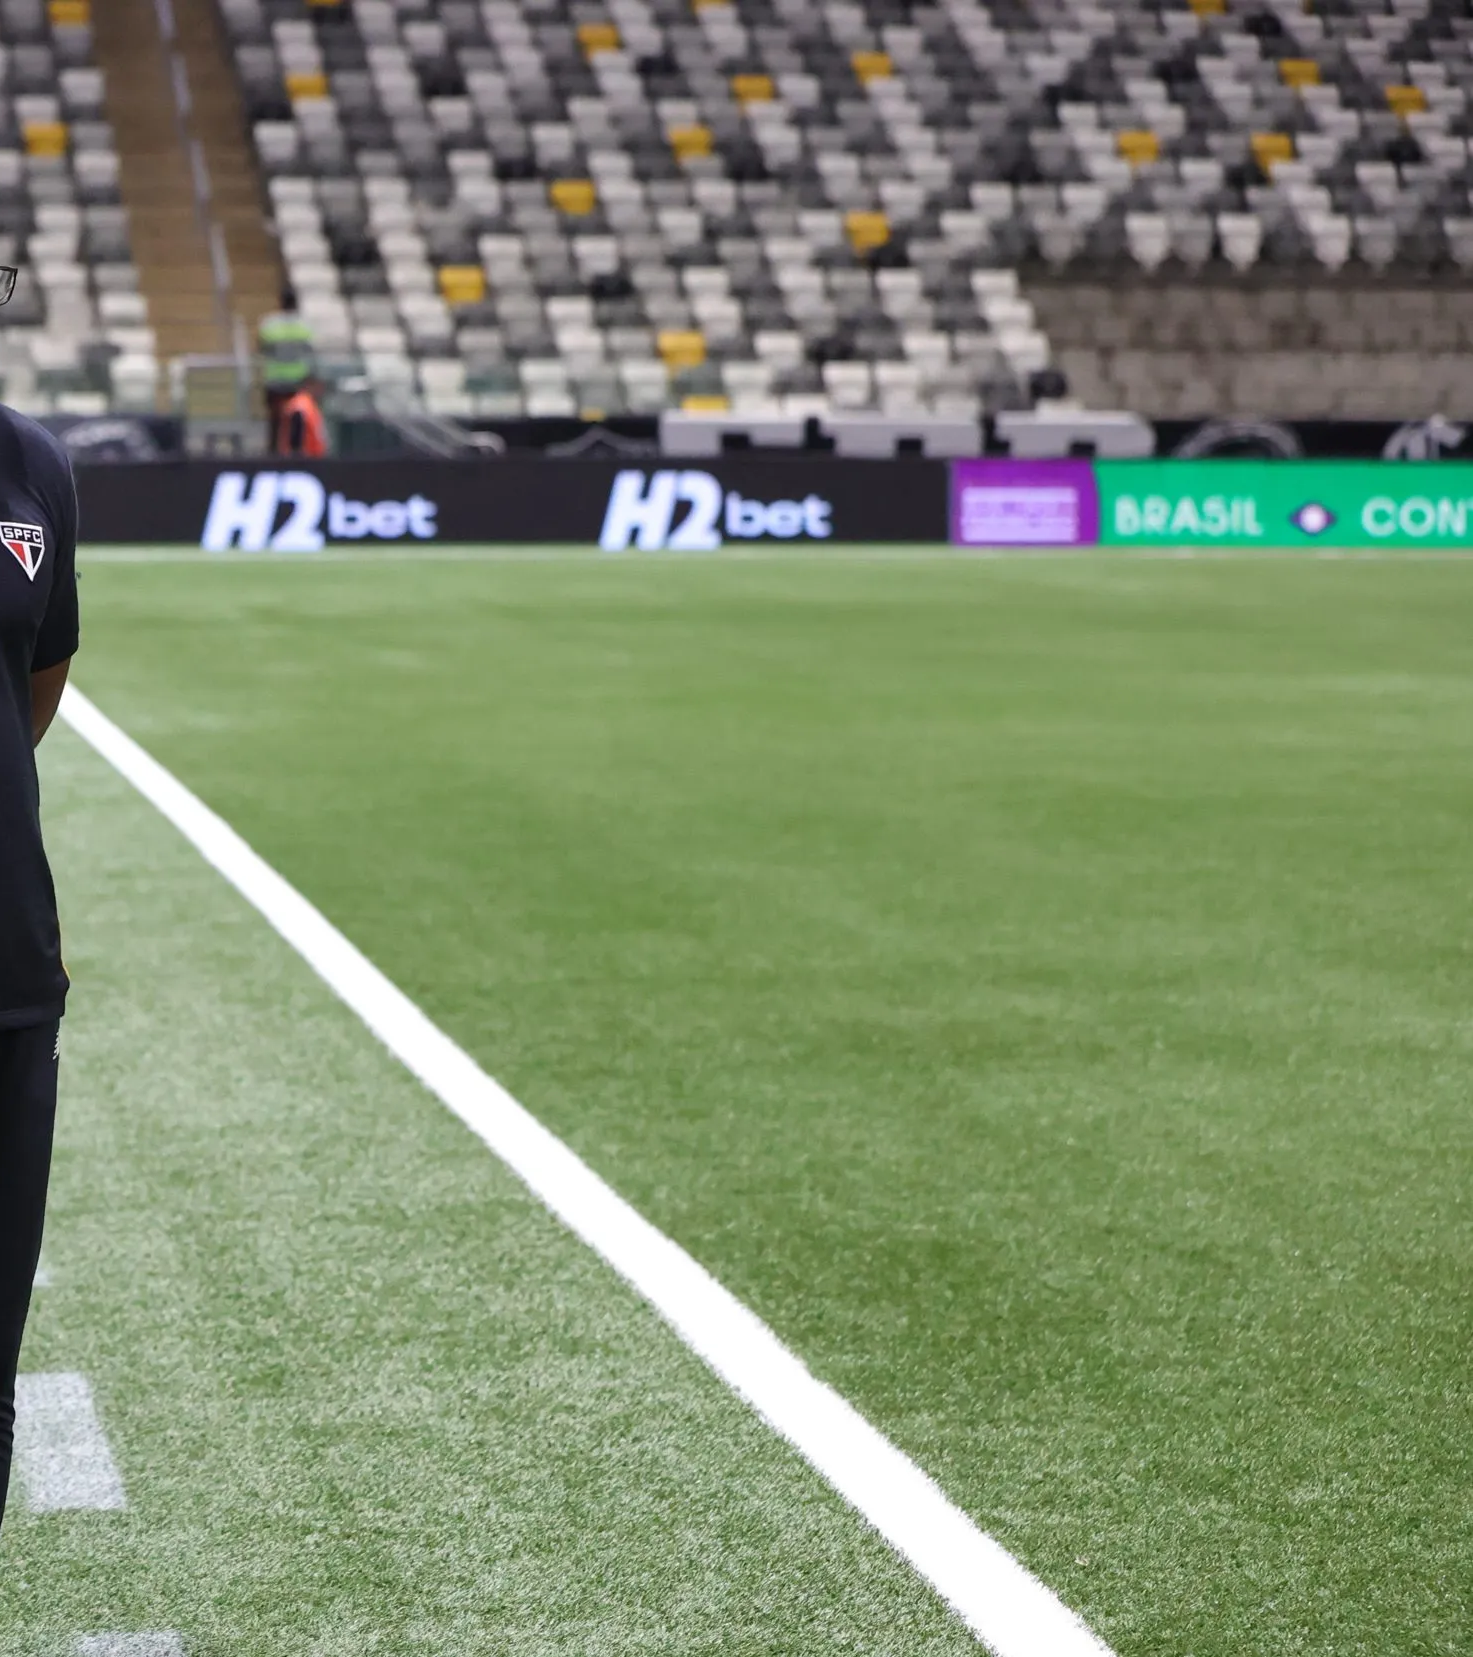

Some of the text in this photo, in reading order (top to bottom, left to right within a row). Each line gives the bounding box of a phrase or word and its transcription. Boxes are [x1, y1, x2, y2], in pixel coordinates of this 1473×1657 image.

[3, 527, 41, 543] SPFC
[1112, 494, 1265, 538] BRASIL
[1361, 494, 1473, 538] CON
